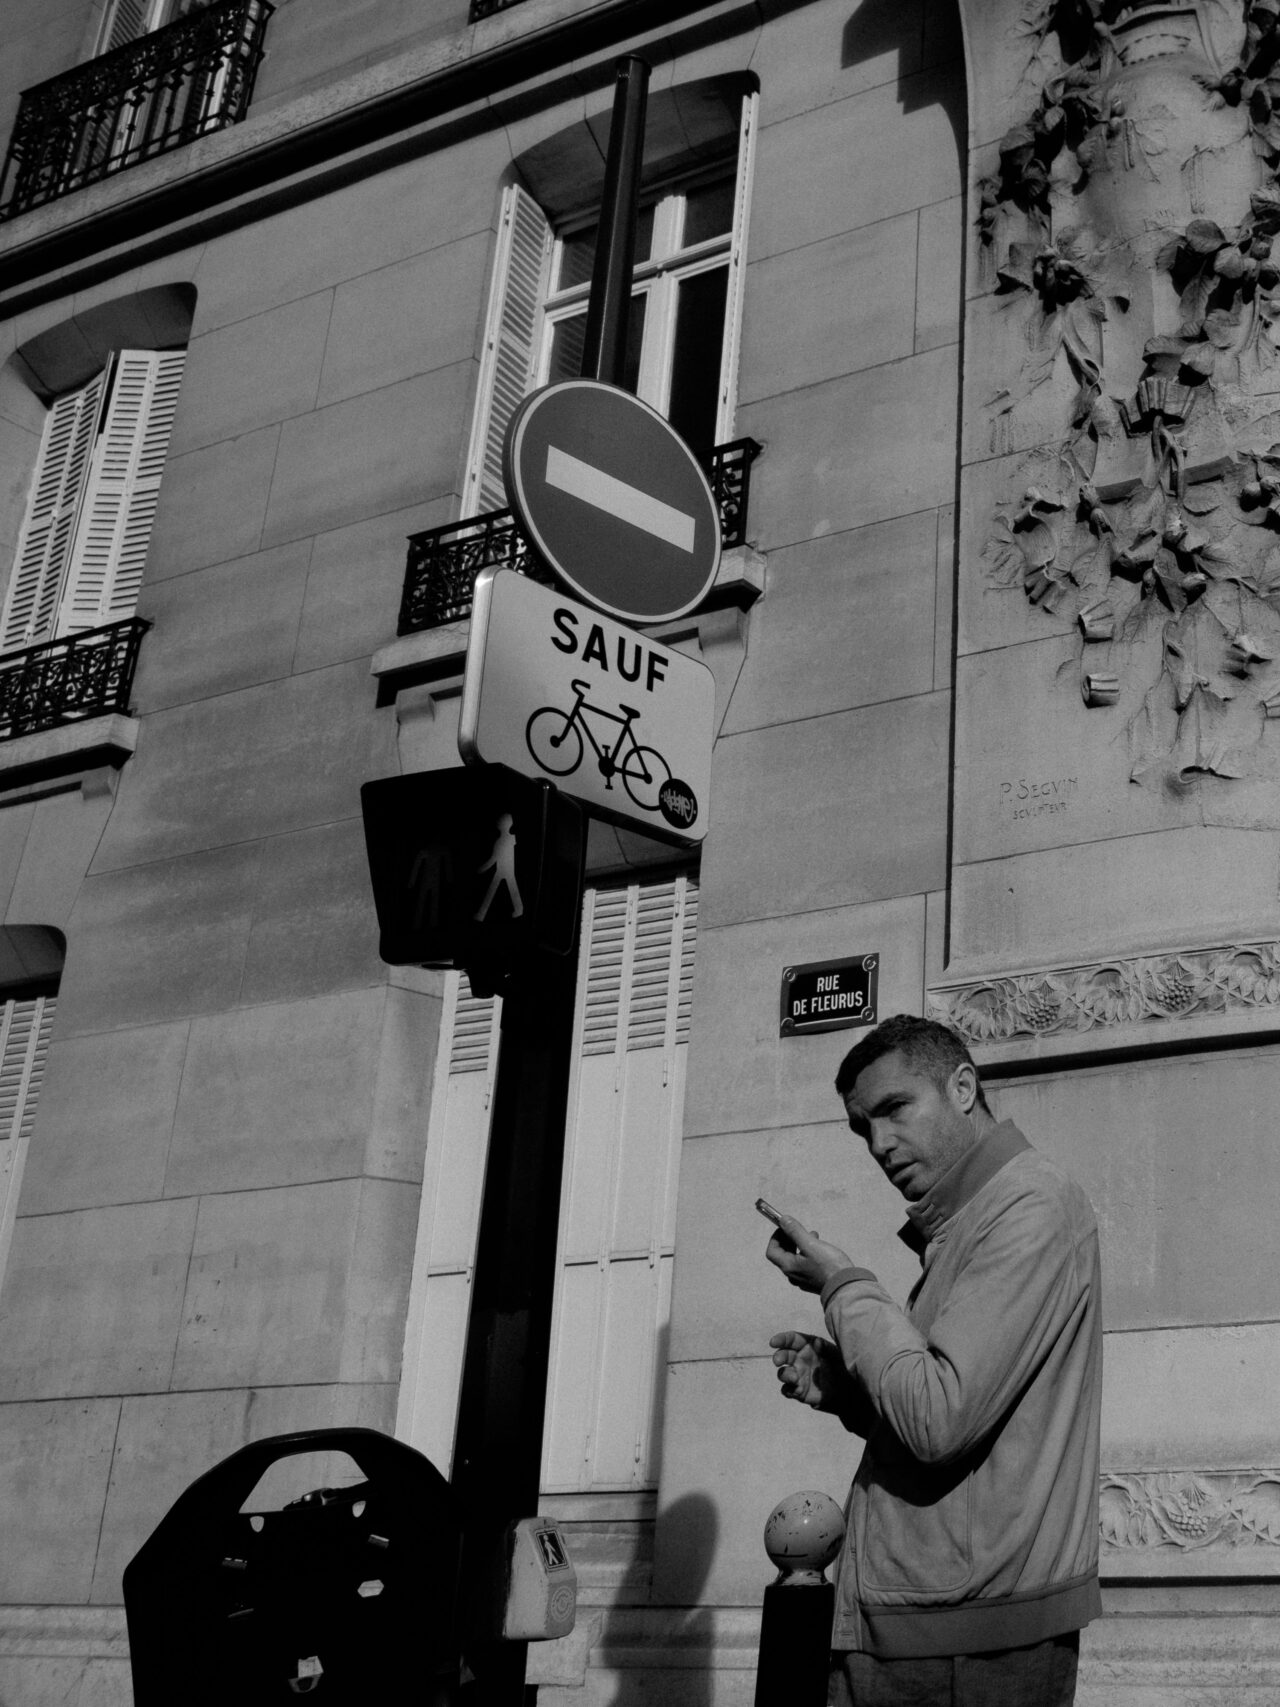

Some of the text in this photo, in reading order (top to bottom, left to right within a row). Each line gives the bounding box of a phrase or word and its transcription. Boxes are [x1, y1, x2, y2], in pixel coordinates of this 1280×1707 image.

[550, 608, 669, 692] SAUF
[816, 974, 840, 993] RUE
[793, 991, 863, 1016] DE FLEURUS
